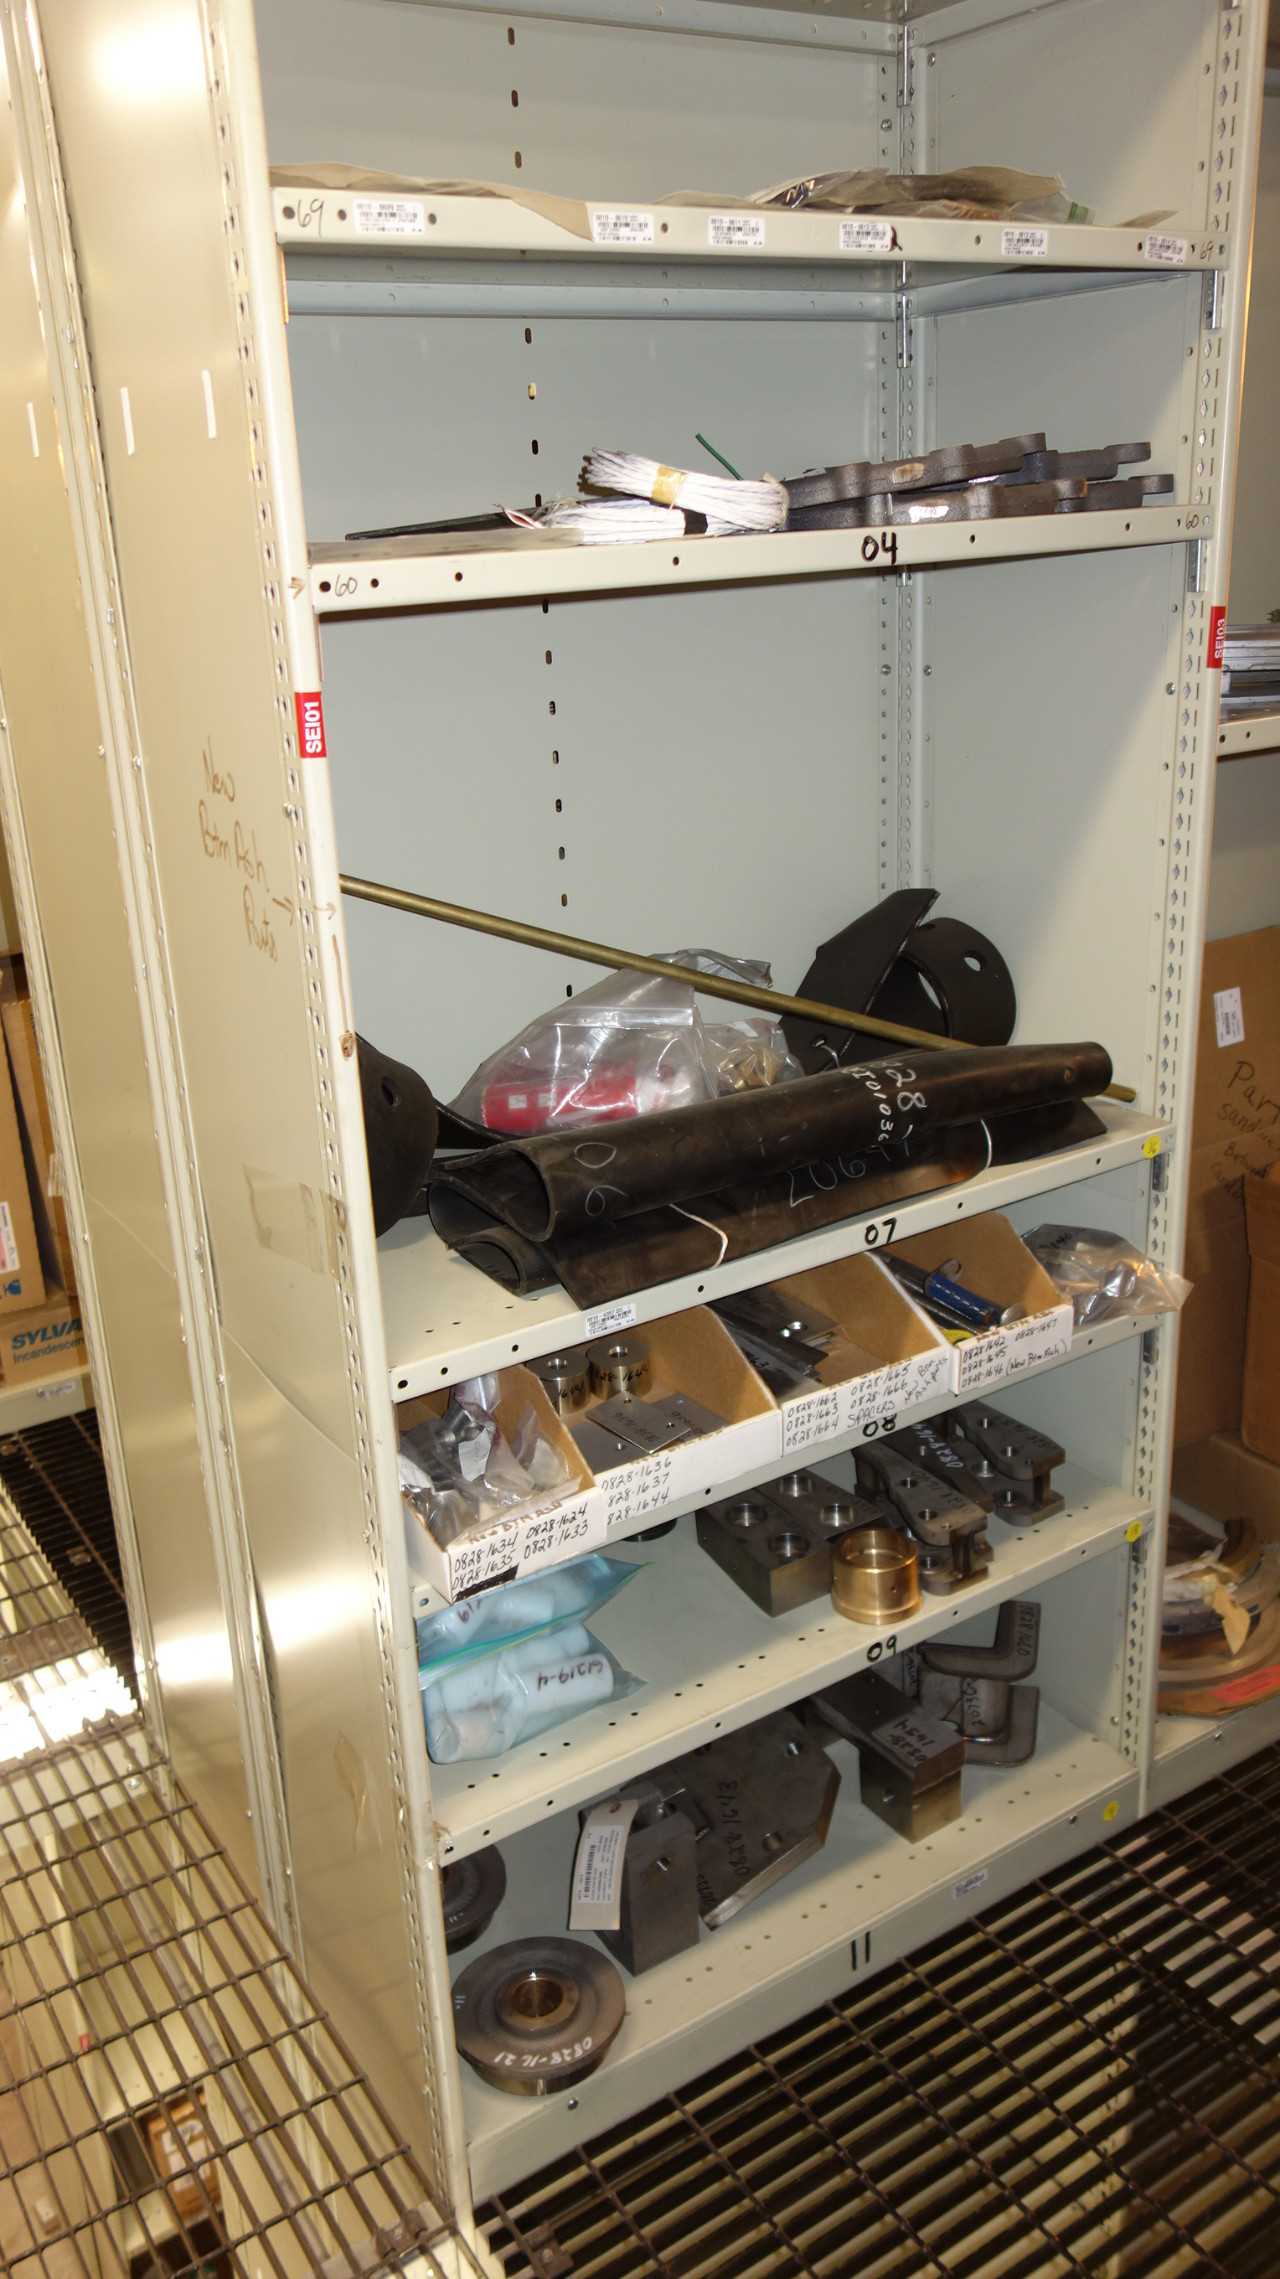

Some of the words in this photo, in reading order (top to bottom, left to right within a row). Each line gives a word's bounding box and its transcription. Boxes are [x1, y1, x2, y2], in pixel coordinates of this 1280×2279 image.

[297, 199, 324, 239] 69
[860, 531, 899, 565] 04
[334, 574, 358, 597] 60
[303, 701, 322, 754] SEI01
[865, 1217, 897, 1246] 07
[11, 1317, 82, 1350] SYLVA
[862, 1413, 898, 1437] 08
[866, 1634, 898, 1663] 09
[851, 1931, 871, 1971] 11
